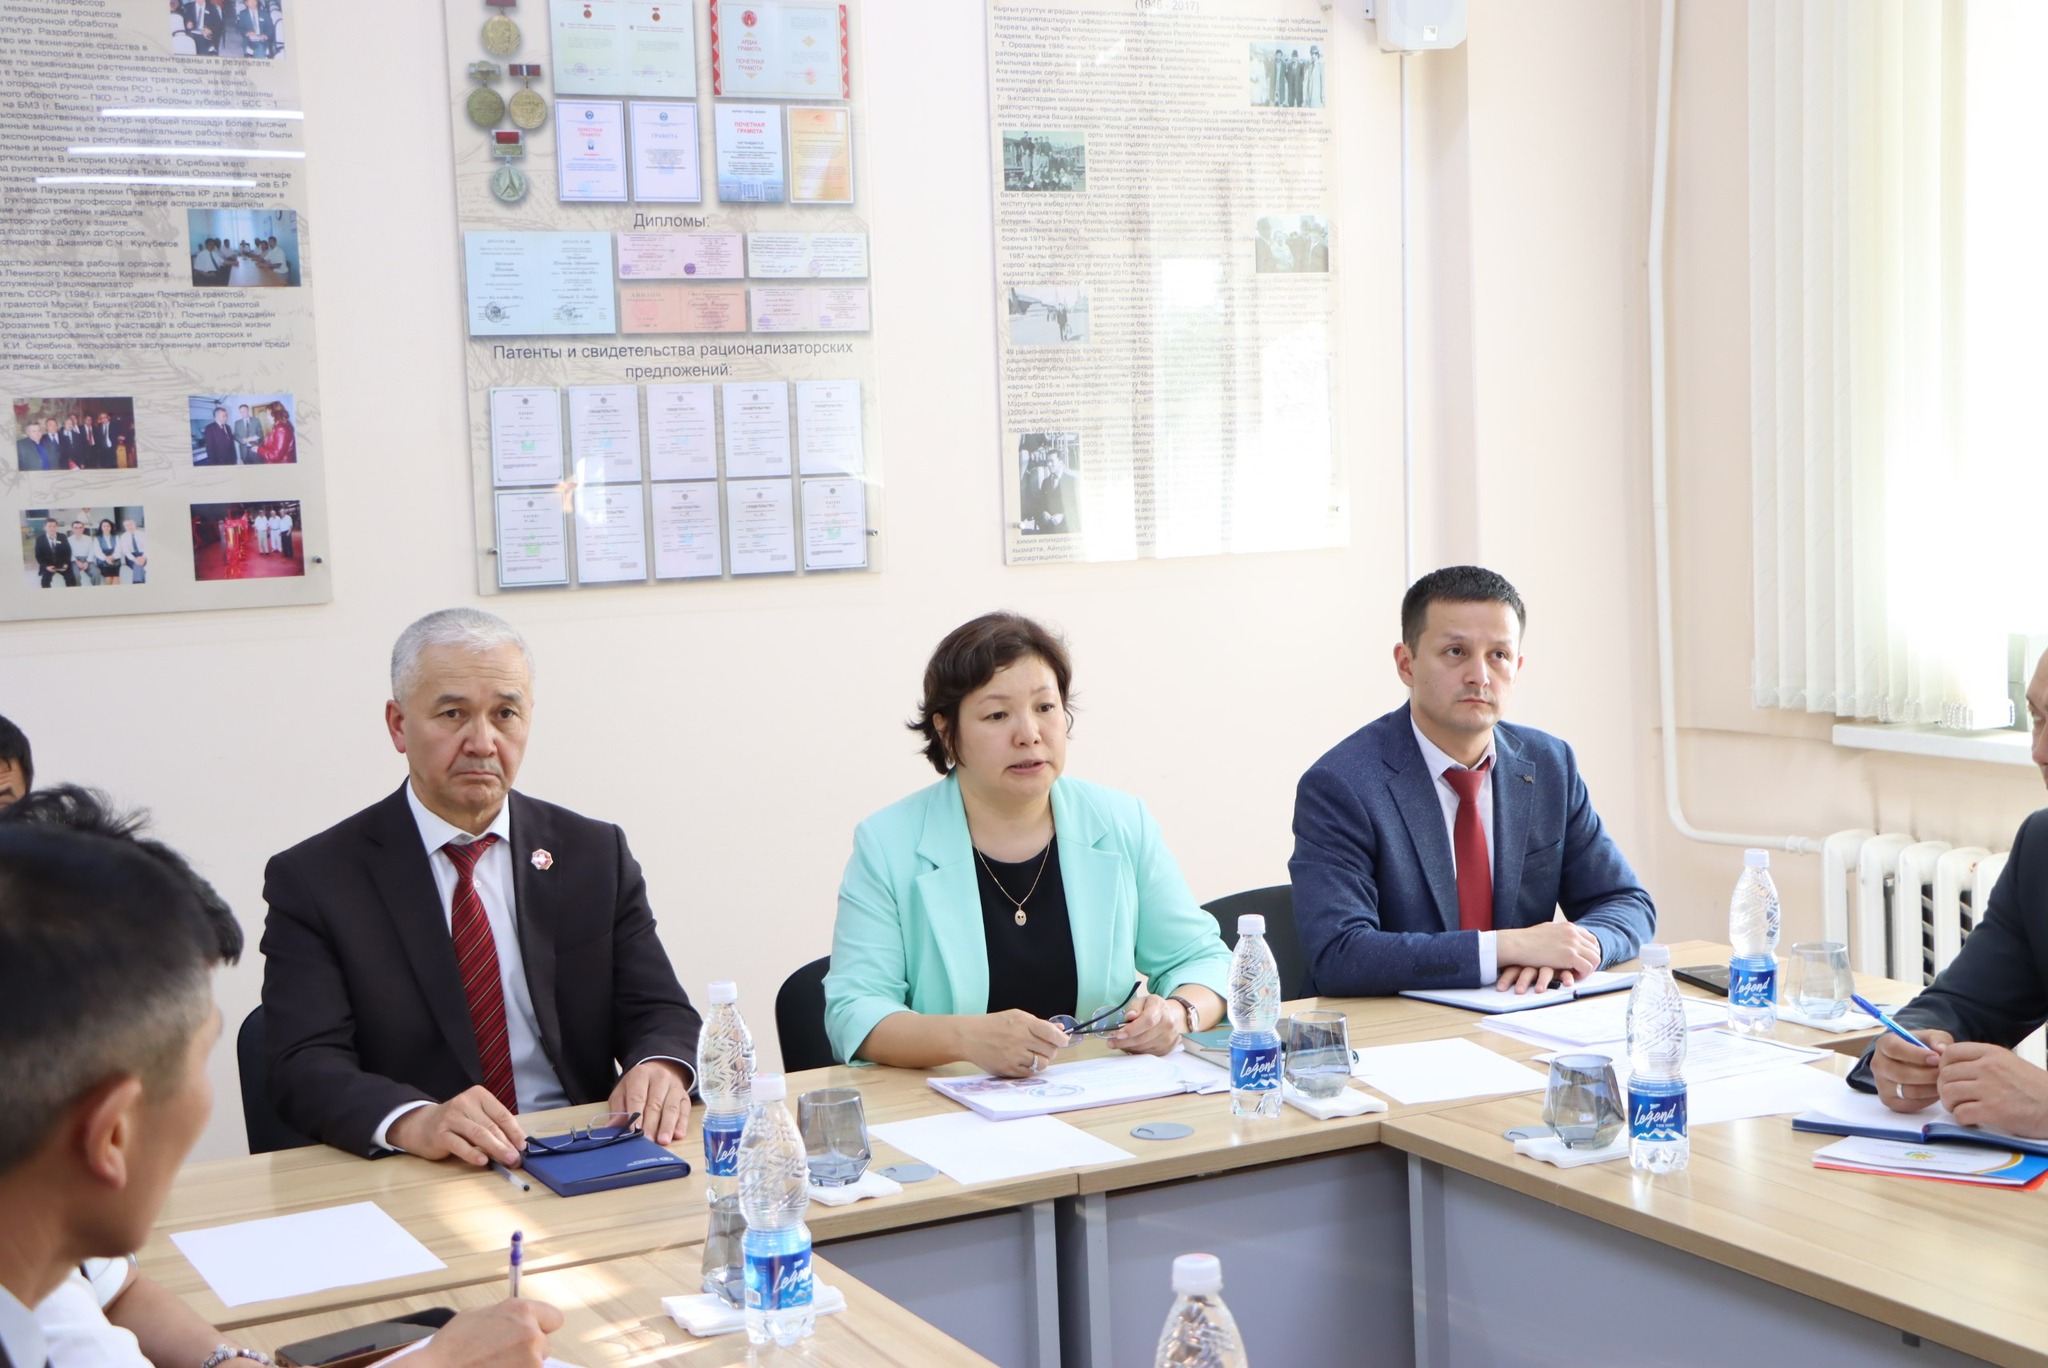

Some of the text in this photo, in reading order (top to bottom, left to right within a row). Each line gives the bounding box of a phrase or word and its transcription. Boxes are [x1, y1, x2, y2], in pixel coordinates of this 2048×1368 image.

[4, 5, 121, 18] механизации процессов
[994, 5, 1019, 14] Кыргыз
[69, 20, 118, 28] обработки
[34, 39, 139, 52] технические средства
[86, 53, 131, 61] основном
[31, 61, 95, 70] механизации
[183, 68, 232, 76] созданные
[7, 80, 57, 89] огородной
[60, 82, 93, 91] ручной
[181, 89, 211, 97] другие
[24, 91, 79, 100] оборотного
[91, 94, 111, 102] ПКО
[157, 97, 191, 105] бороны
[55, 103, 94, 112] Бишкек)
[97, 116, 132, 124] культур
[182, 119, 223, 128] площади
[226, 119, 252, 127] более
[1, 133, 75, 142] экспонированы
[196, 129, 232, 137] рабочие
[177, 158, 220, 168] Скрябина
[12, 165, 78, 174] руководством
[81, 168, 138, 176] профессора
[41, 186, 85, 196] Лауреата
[89, 189, 123, 197] премии
[126, 189, 196, 198] Правительства
[171, 200, 217, 208] аспиранта
[18, 208, 50, 216] ученой
[52, 219, 83, 227] работу
[633, 212, 710, 228] Дипломы:
[9, 229, 66, 237] подготовкой
[87, 261, 124, 269] рабочих
[6, 270, 60, 278] Ленинского
[119, 271, 161, 279] Киргизии
[57, 281, 133, 289] рационализатор
[46, 311, 94, 319] Таласской
[115, 322, 166, 330] участвовал
[177, 321, 242, 329] общественной
[1, 332, 103, 340] специализированных
[207, 341, 262, 349] авторитетом
[493, 342, 853, 361] Патенты и свидетельства рационализаторских
[13, 363, 41, 371] детей
[625, 363, 733, 380] предложений:
[1735, 976, 1770, 997] Legend
[1240, 1054, 1277, 1079] Legend
[1634, 1103, 1677, 1128] Legend
